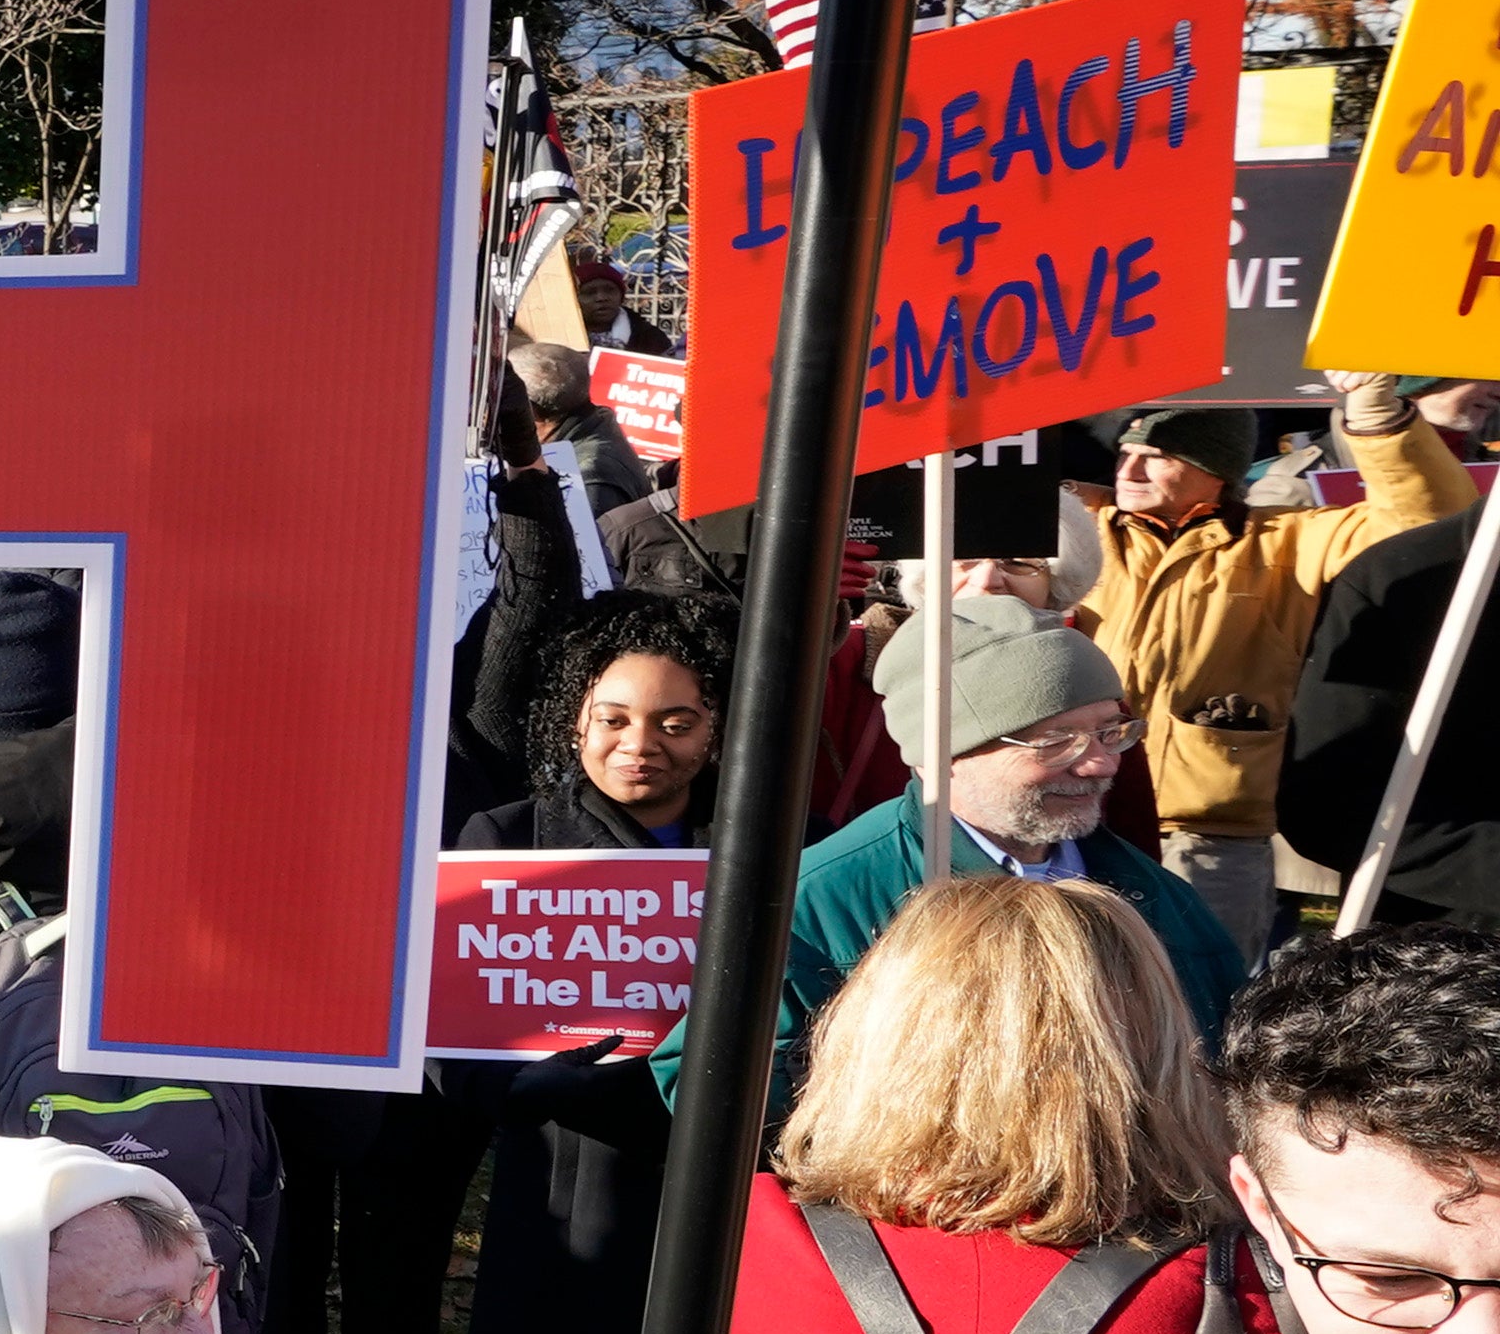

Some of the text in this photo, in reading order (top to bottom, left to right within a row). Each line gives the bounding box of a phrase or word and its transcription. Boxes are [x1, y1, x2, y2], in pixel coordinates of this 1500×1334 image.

[732, 20, 1197, 249] IPEACH
[864, 237, 1161, 409] EMOVE
[481, 879, 661, 925] Trump
[458, 924, 553, 960] Not
[478, 968, 581, 1006] The
